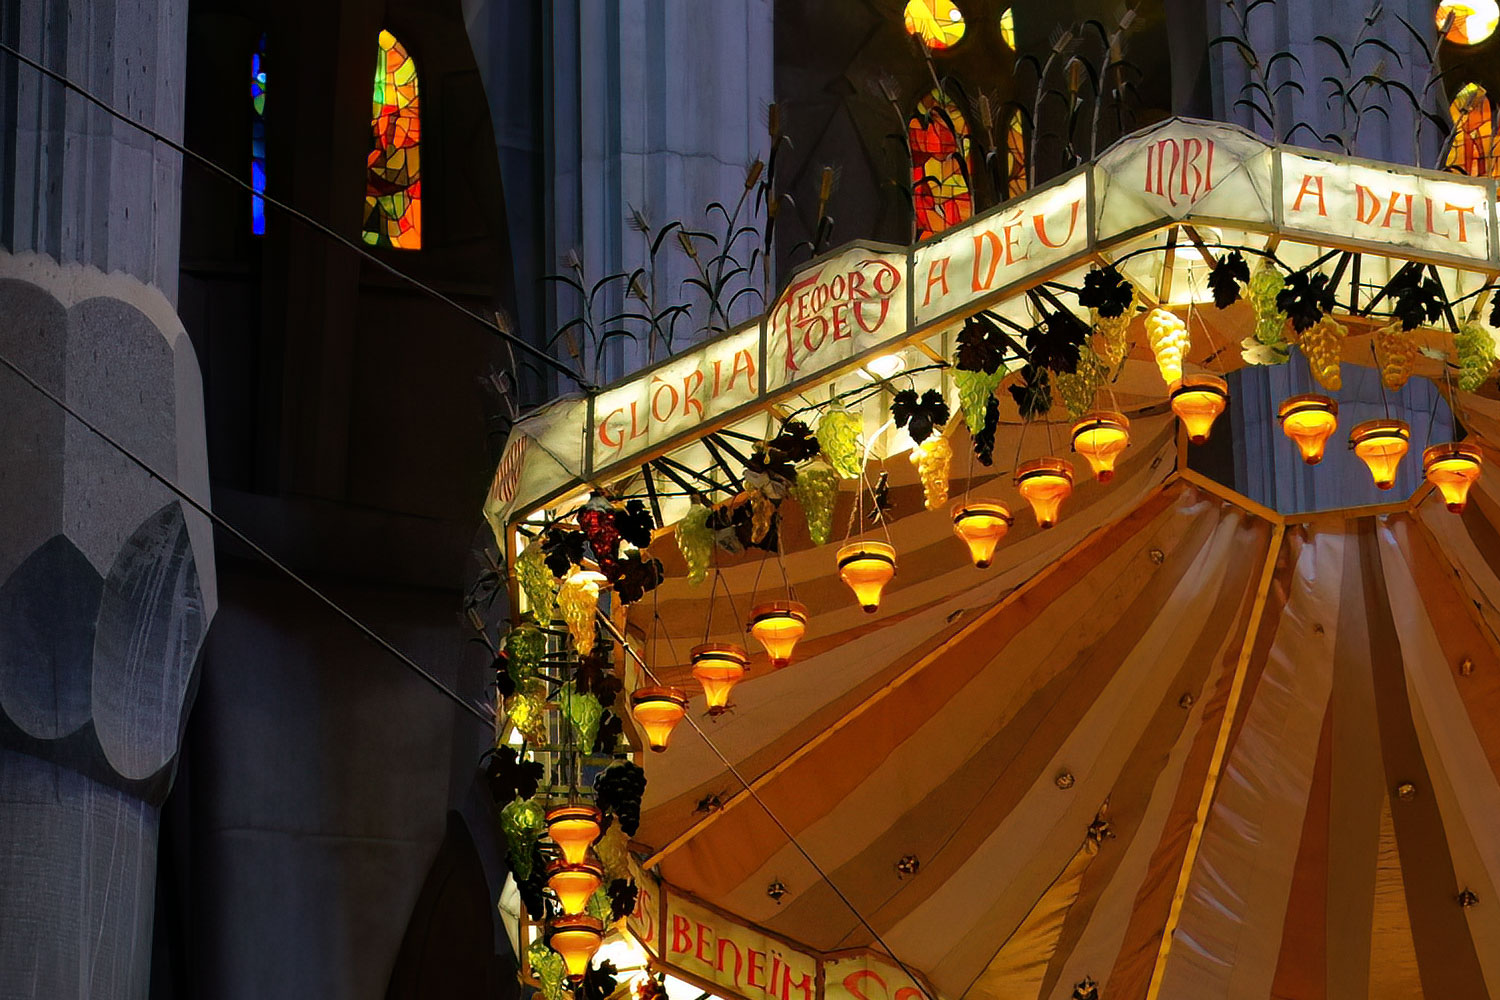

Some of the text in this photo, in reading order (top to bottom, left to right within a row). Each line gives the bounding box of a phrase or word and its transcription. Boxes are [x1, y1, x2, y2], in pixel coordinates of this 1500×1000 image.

[1145, 137, 1213, 206] INRI
[1292, 174, 1475, 243] A DALT
[923, 200, 1080, 306] A DÉU
[598, 349, 757, 455] GLÒRIA
